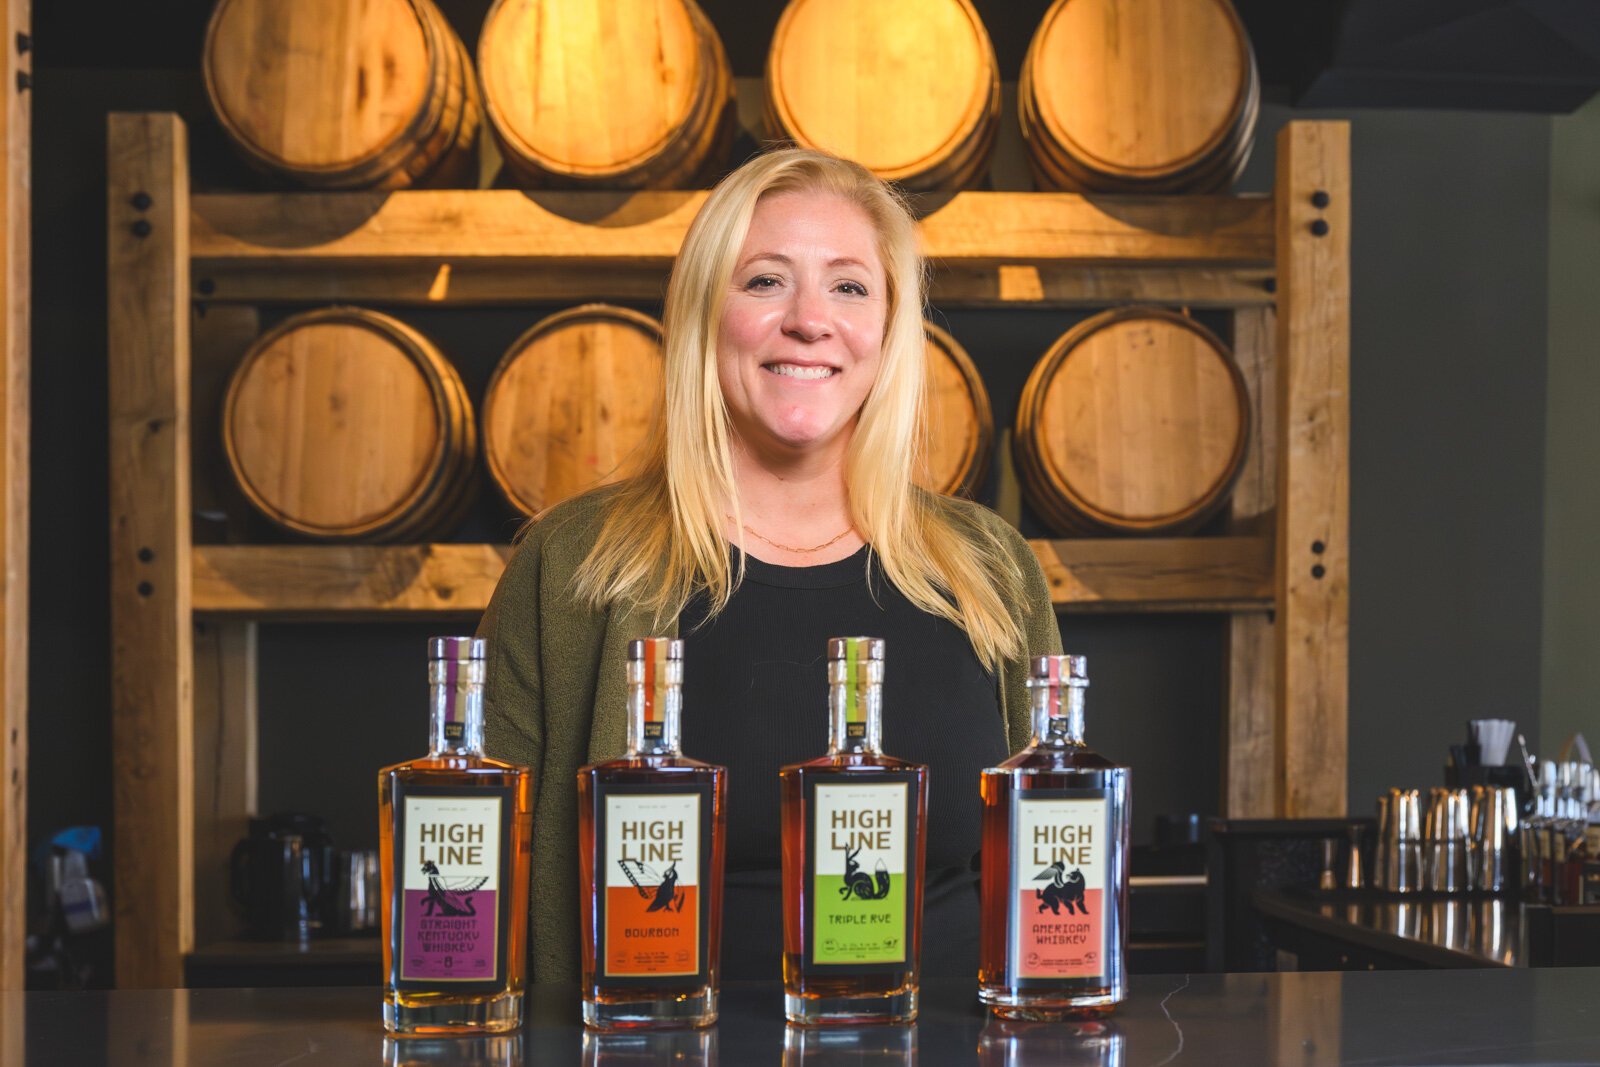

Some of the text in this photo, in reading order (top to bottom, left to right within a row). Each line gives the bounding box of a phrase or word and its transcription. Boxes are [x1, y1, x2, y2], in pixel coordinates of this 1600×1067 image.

[831, 810, 892, 829] HIGH
[420, 823, 484, 843] HIGH
[622, 821, 683, 840] HIGH
[1033, 825, 1092, 844] HIGH
[831, 831, 891, 850] LINE
[419, 846, 482, 865] LINE
[621, 843, 683, 862] LINE
[1033, 847, 1091, 865] LINE
[420, 919, 477, 930] STRAIGHT
[828, 914, 891, 925] TRIPLE RYE
[1032, 923, 1090, 934] AMERICAN
[417, 931, 480, 941] KENTUCKY
[624, 928, 679, 938] BOURBON
[1036, 935, 1087, 945] WHISKEY
[422, 943, 474, 953] WHISKEY
